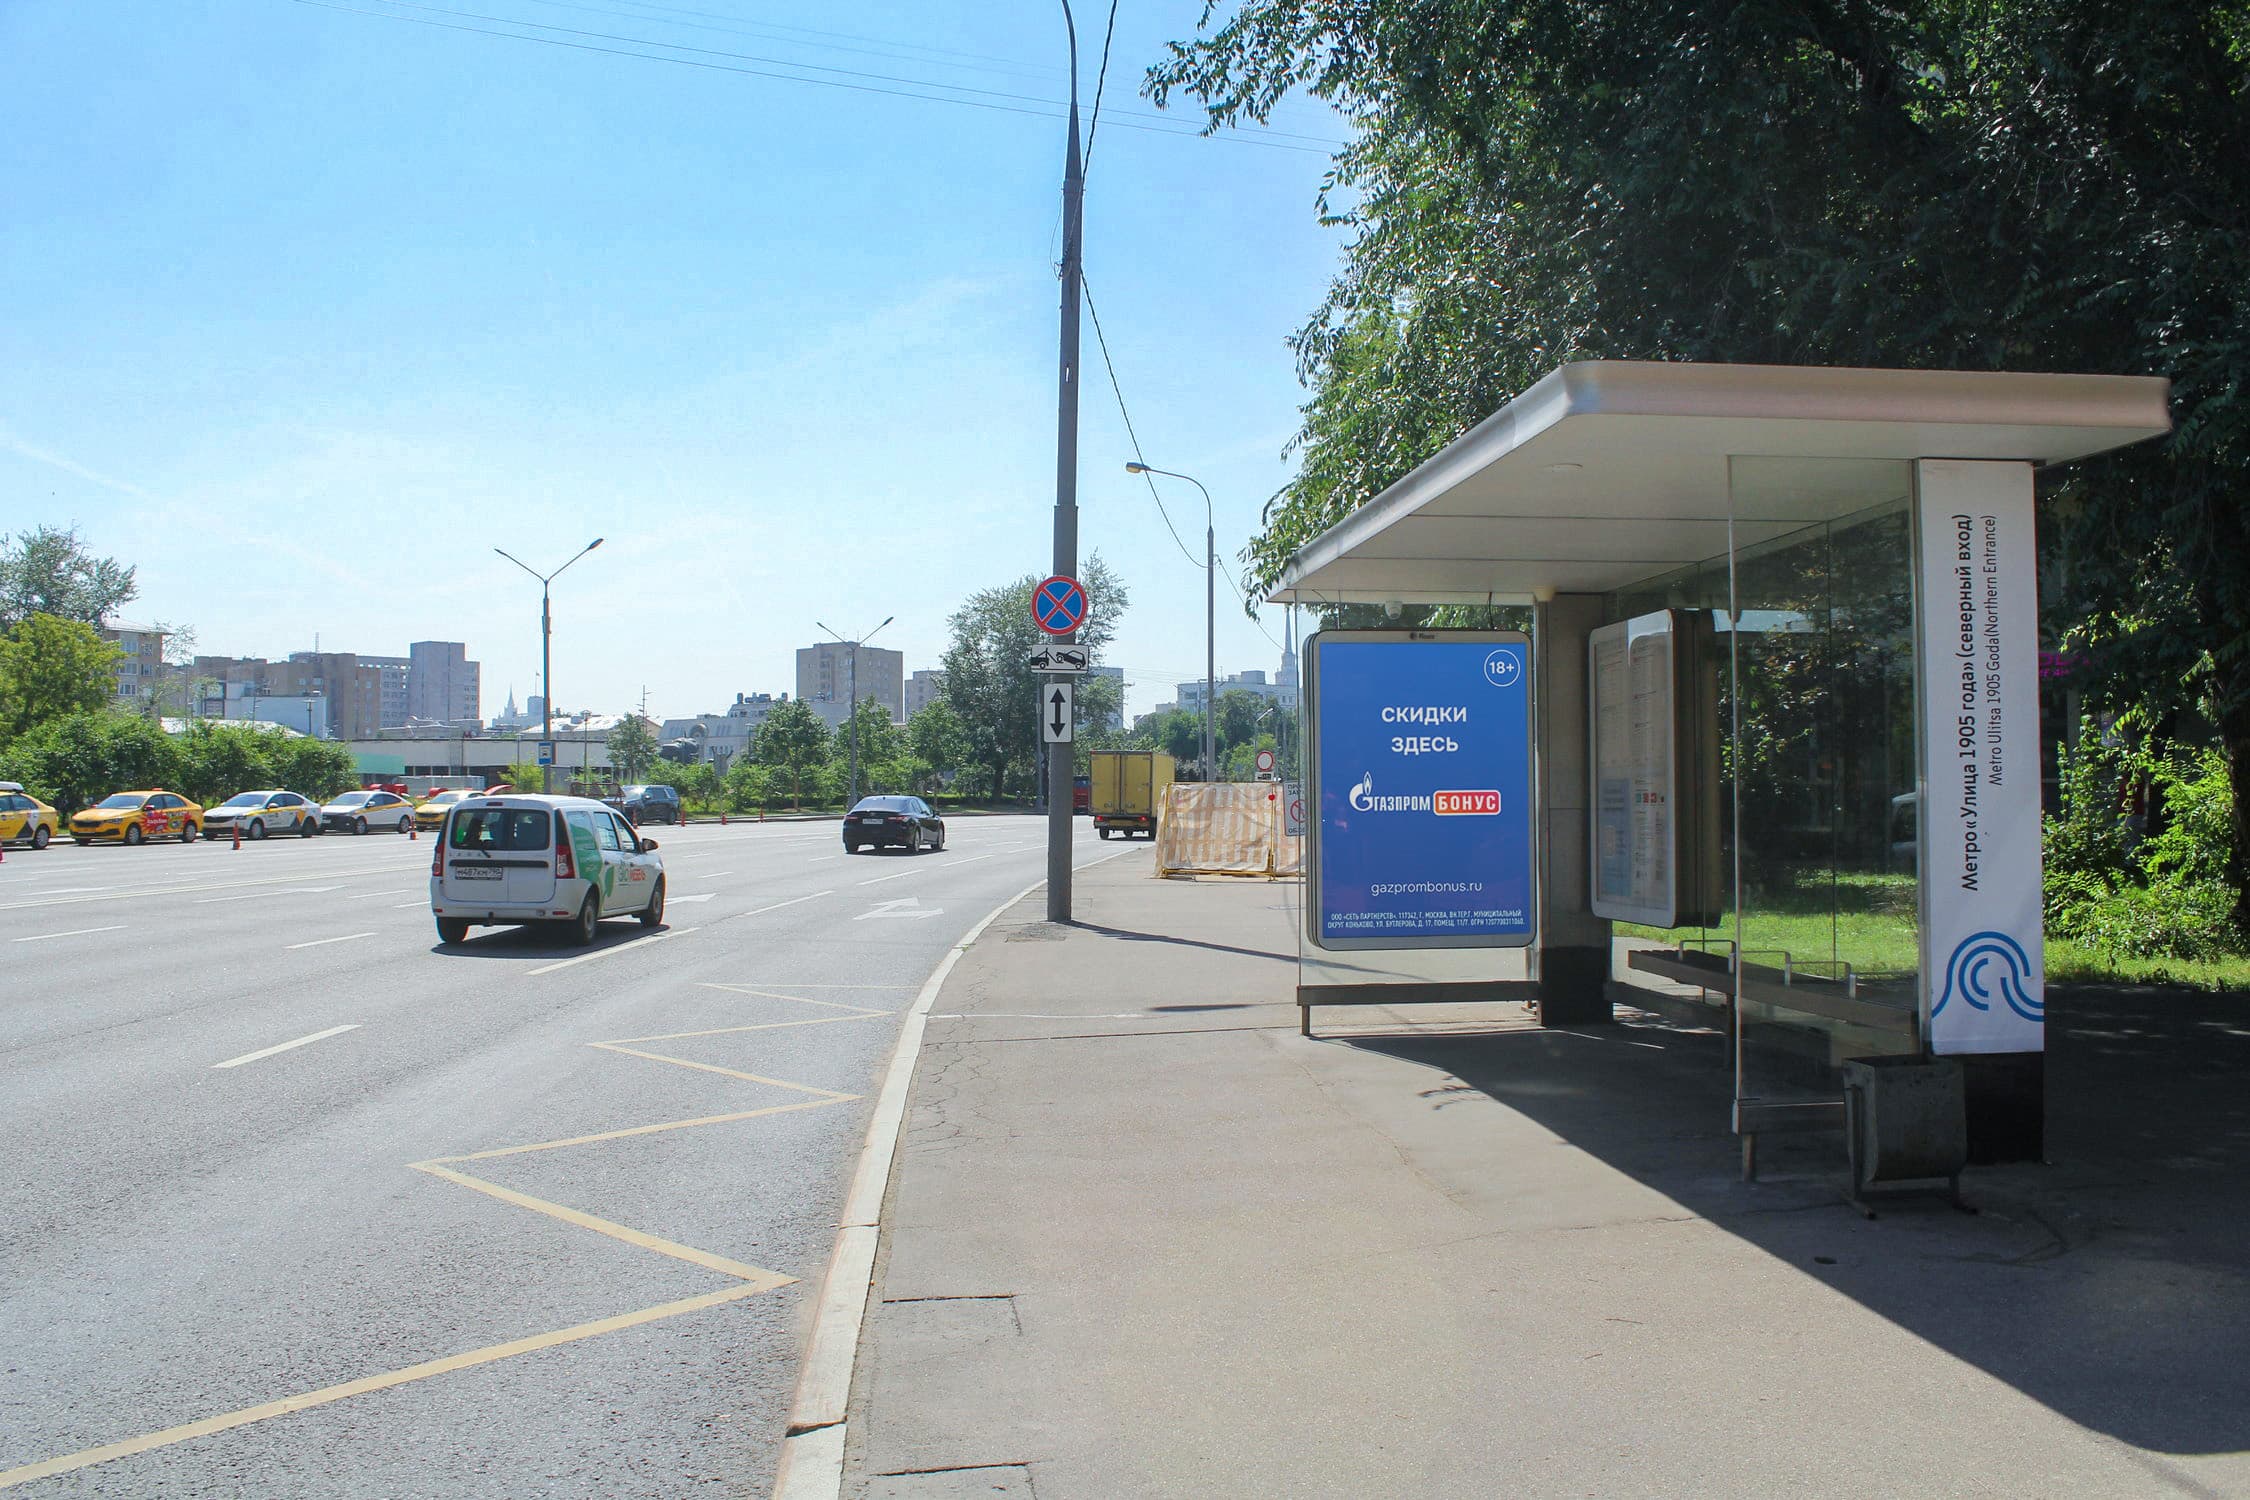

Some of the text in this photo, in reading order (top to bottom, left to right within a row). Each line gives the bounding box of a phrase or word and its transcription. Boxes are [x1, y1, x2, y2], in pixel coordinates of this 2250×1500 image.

[1951, 513, 1973, 561] вход)
[1979, 515, 1998, 573] Entrance)
[1954, 565, 1977, 658] (северный
[1489, 661, 1515, 675] 18+
[1958, 661, 1977, 711] года»
[1985, 673, 2001, 704] 1905
[1381, 706, 1468, 726] СКИДКИ
[1986, 707, 2002, 744] Ulitsa
[1391, 736, 1459, 756] ЗДЕСЬ
[1958, 715, 1977, 759] 1905
[1988, 746, 2003, 787] Metro
[1373, 794, 1497, 812] ГАЗПРОМ БОНУС
[1370, 881, 1483, 897] gazprombonus.ru
[1327, 920, 1344, 929] ОКРУГ
[1330, 913, 1342, 921] ООО
